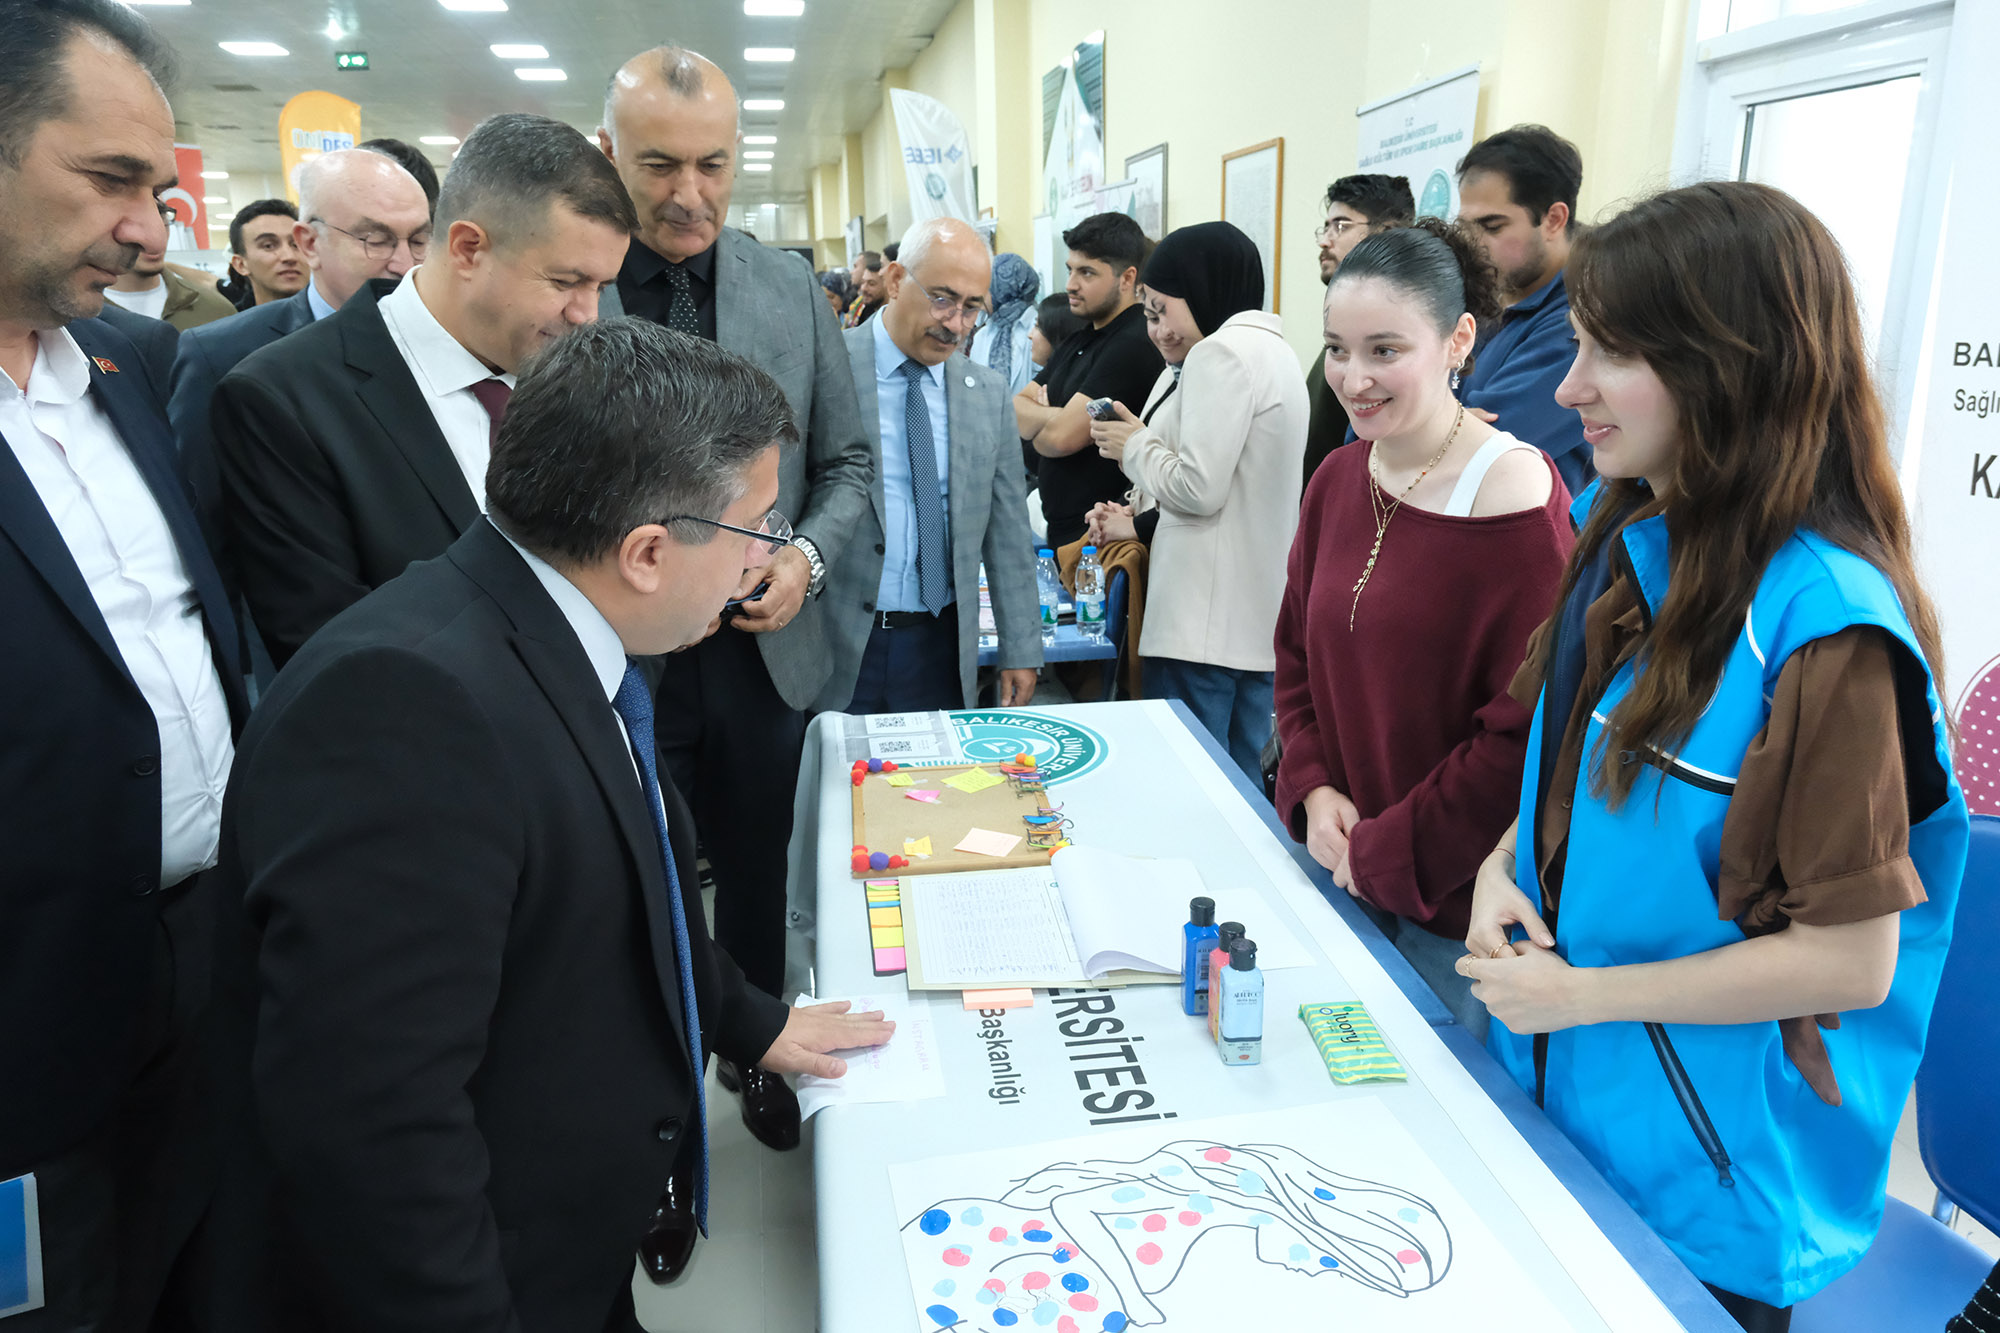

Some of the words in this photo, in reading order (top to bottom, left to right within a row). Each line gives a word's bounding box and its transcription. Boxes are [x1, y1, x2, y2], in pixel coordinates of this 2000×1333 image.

[1970, 453, 2000, 499] K
[1332, 1012, 1361, 1043] Ivory
[976, 1008, 1027, 1105] Başkanlığı
